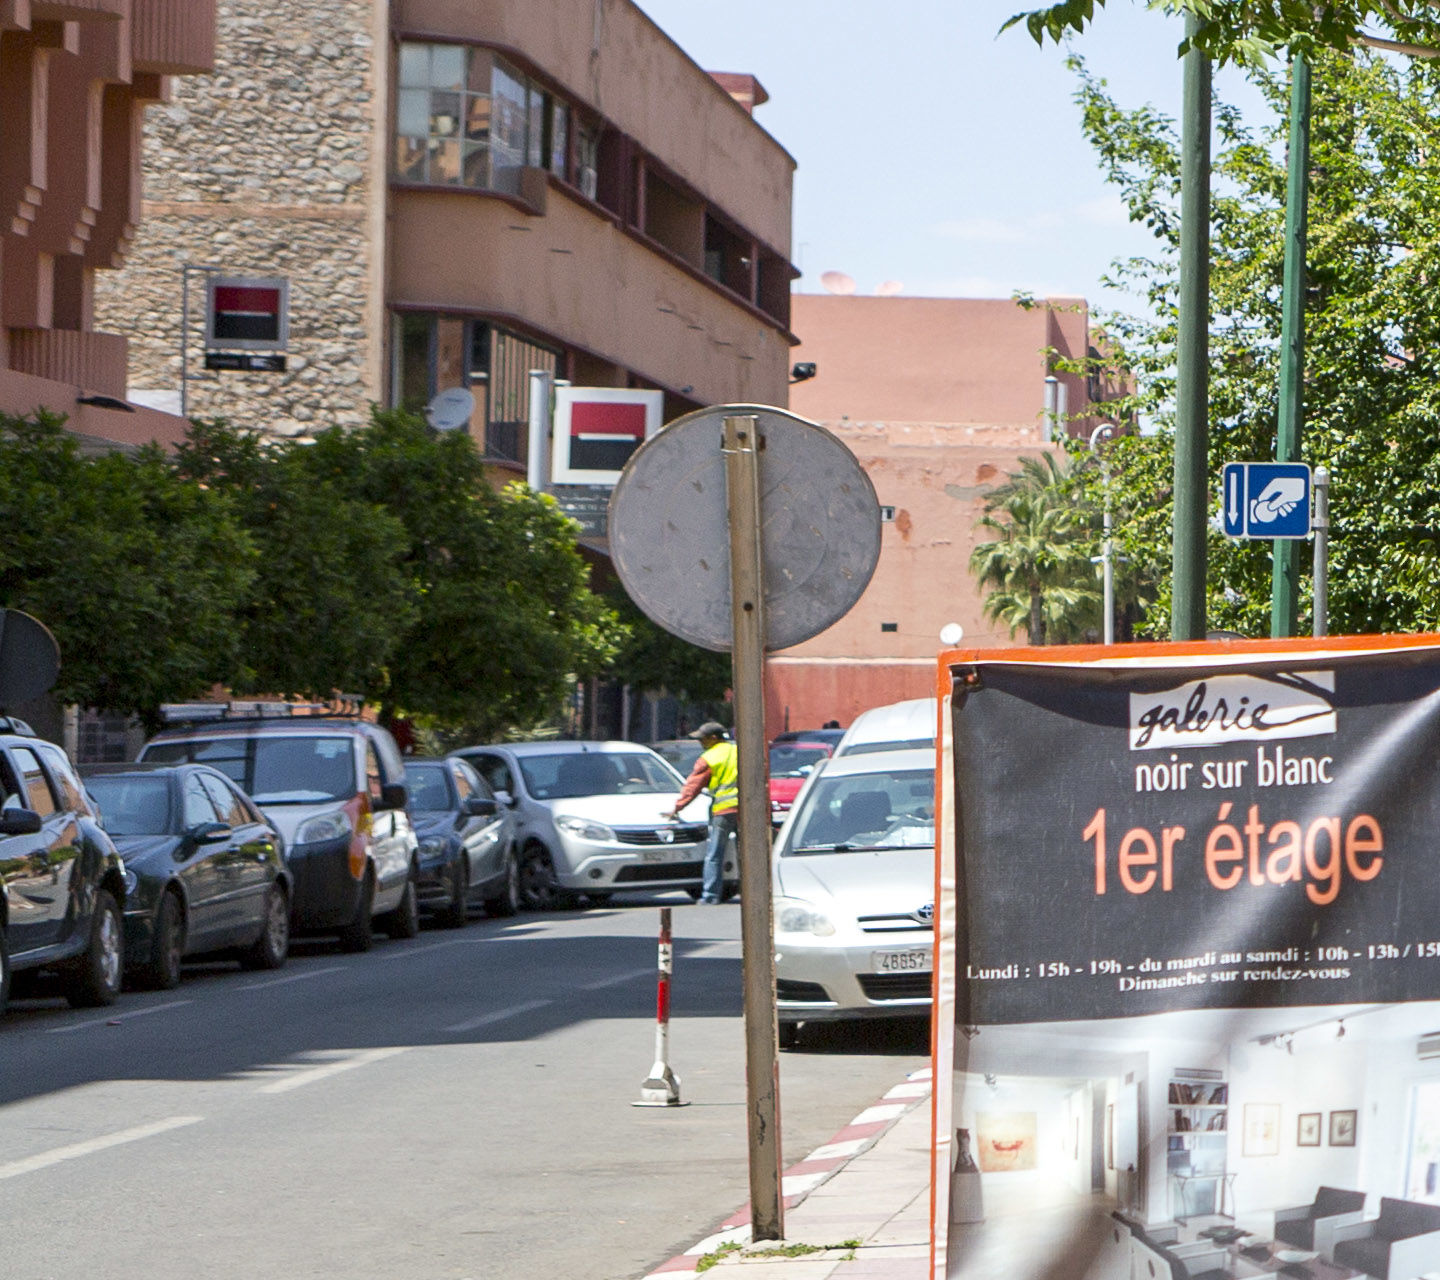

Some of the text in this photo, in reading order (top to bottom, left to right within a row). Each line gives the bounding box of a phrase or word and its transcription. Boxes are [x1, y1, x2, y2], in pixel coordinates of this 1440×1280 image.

[1135, 681, 1305, 748] galerie
[1136, 747, 1333, 792] noir sur blanc
[1082, 802, 1384, 906] 1er étage
[967, 965, 1019, 980] Lundi
[1038, 961, 1070, 977] 15h
[1090, 960, 1122, 975] 19h
[1139, 958, 1161, 972] du
[1167, 951, 1216, 970] mardi
[1220, 954, 1242, 964] au
[1246, 948, 1299, 963] samdi
[1317, 947, 1349, 961] 10h
[1368, 944, 1400, 959] 13h
[1119, 967, 1350, 992] Dimanche sur rendez-vous
